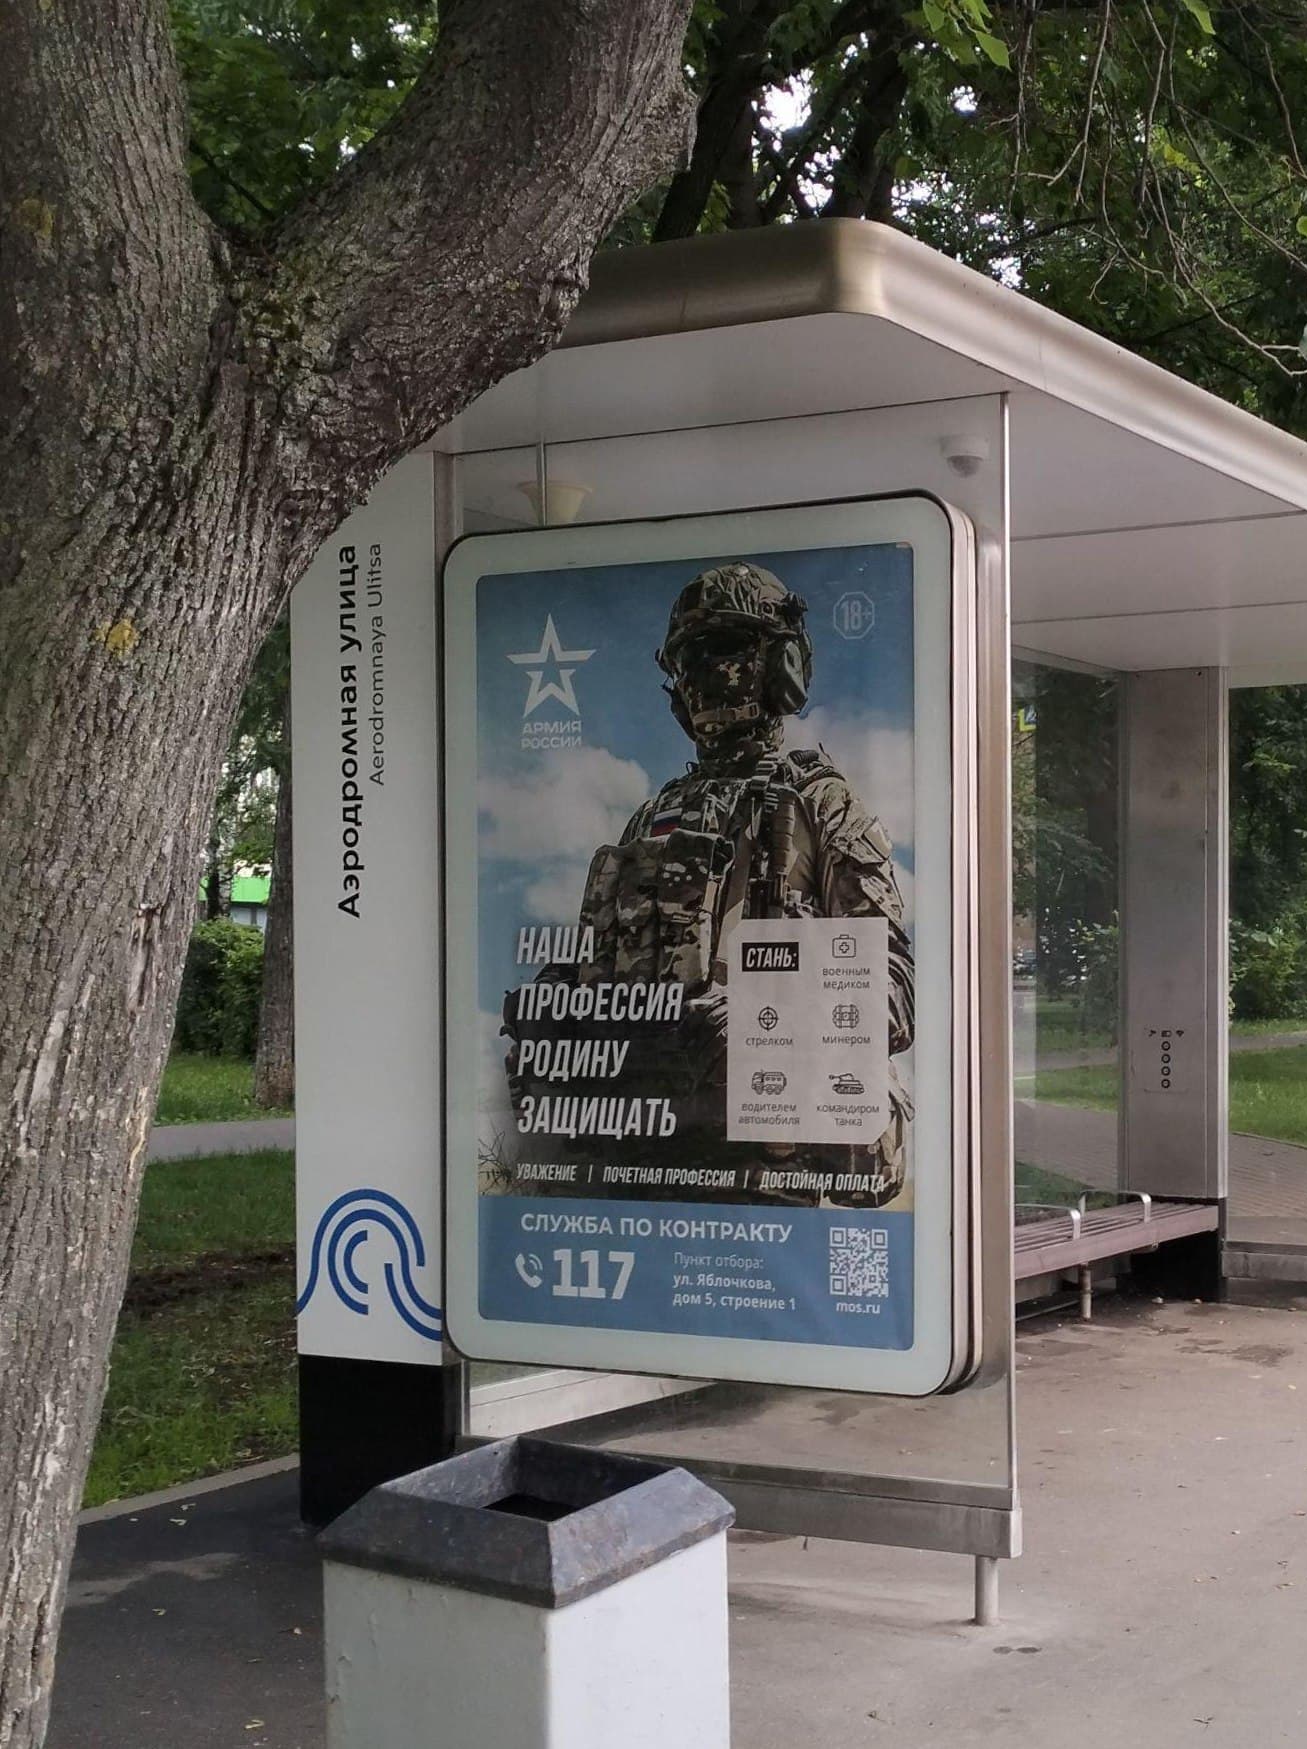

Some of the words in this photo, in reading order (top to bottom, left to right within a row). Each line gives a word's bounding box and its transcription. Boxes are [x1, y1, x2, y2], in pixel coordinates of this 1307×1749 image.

[367, 543, 383, 607] Ulitsa
[337, 545, 362, 652] улица
[368, 615, 387, 786] Aerodromnaya
[522, 720, 582, 734] АРМИЯ
[521, 736, 582, 750] РОССИИ
[338, 664, 365, 918] Аэродромная
[517, 926, 595, 965] НАША
[746, 947, 797, 969] СТАНЬ:
[822, 967, 871, 977] военным
[823, 980, 870, 991] медиком
[516, 982, 685, 1022] ПРОФЕССИЯ
[745, 1036, 794, 1048] стрелком
[822, 1035, 871, 1048] минером
[516, 1039, 631, 1083] РОДИНУ
[741, 1102, 797, 1113] водителем
[816, 1104, 880, 1115] командиром
[517, 1095, 678, 1141] ЗАЩИЩАТЬ
[738, 1113, 801, 1125] автомобиля
[835, 1117, 863, 1127] танка
[516, 1162, 578, 1182] УВАЖЕНИЕ
[602, 1165, 663, 1185] ПОЧЕТНАЯ
[664, 1168, 736, 1189] ПРОФЕССИЯ
[760, 1169, 834, 1191] ДОСТОЙНАЯ
[834, 1173, 886, 1193] ОПЛАТА
[521, 1212, 613, 1236] СЛУЖБА
[620, 1217, 653, 1237] ПО
[659, 1218, 793, 1244] КОНТРАКТУ
[674, 1251, 712, 1269] Пункт
[714, 1254, 765, 1272] отбора:
[552, 1248, 636, 1300] 117
[672, 1274, 693, 1289] ул.
[696, 1273, 776, 1292] Яблочкова,
[672, 1292, 701, 1307] дом
[704, 1292, 717, 1308] 5,
[720, 1294, 786, 1311] строение
[789, 1298, 797, 1311] 1
[836, 1300, 881, 1315] mos.ru
